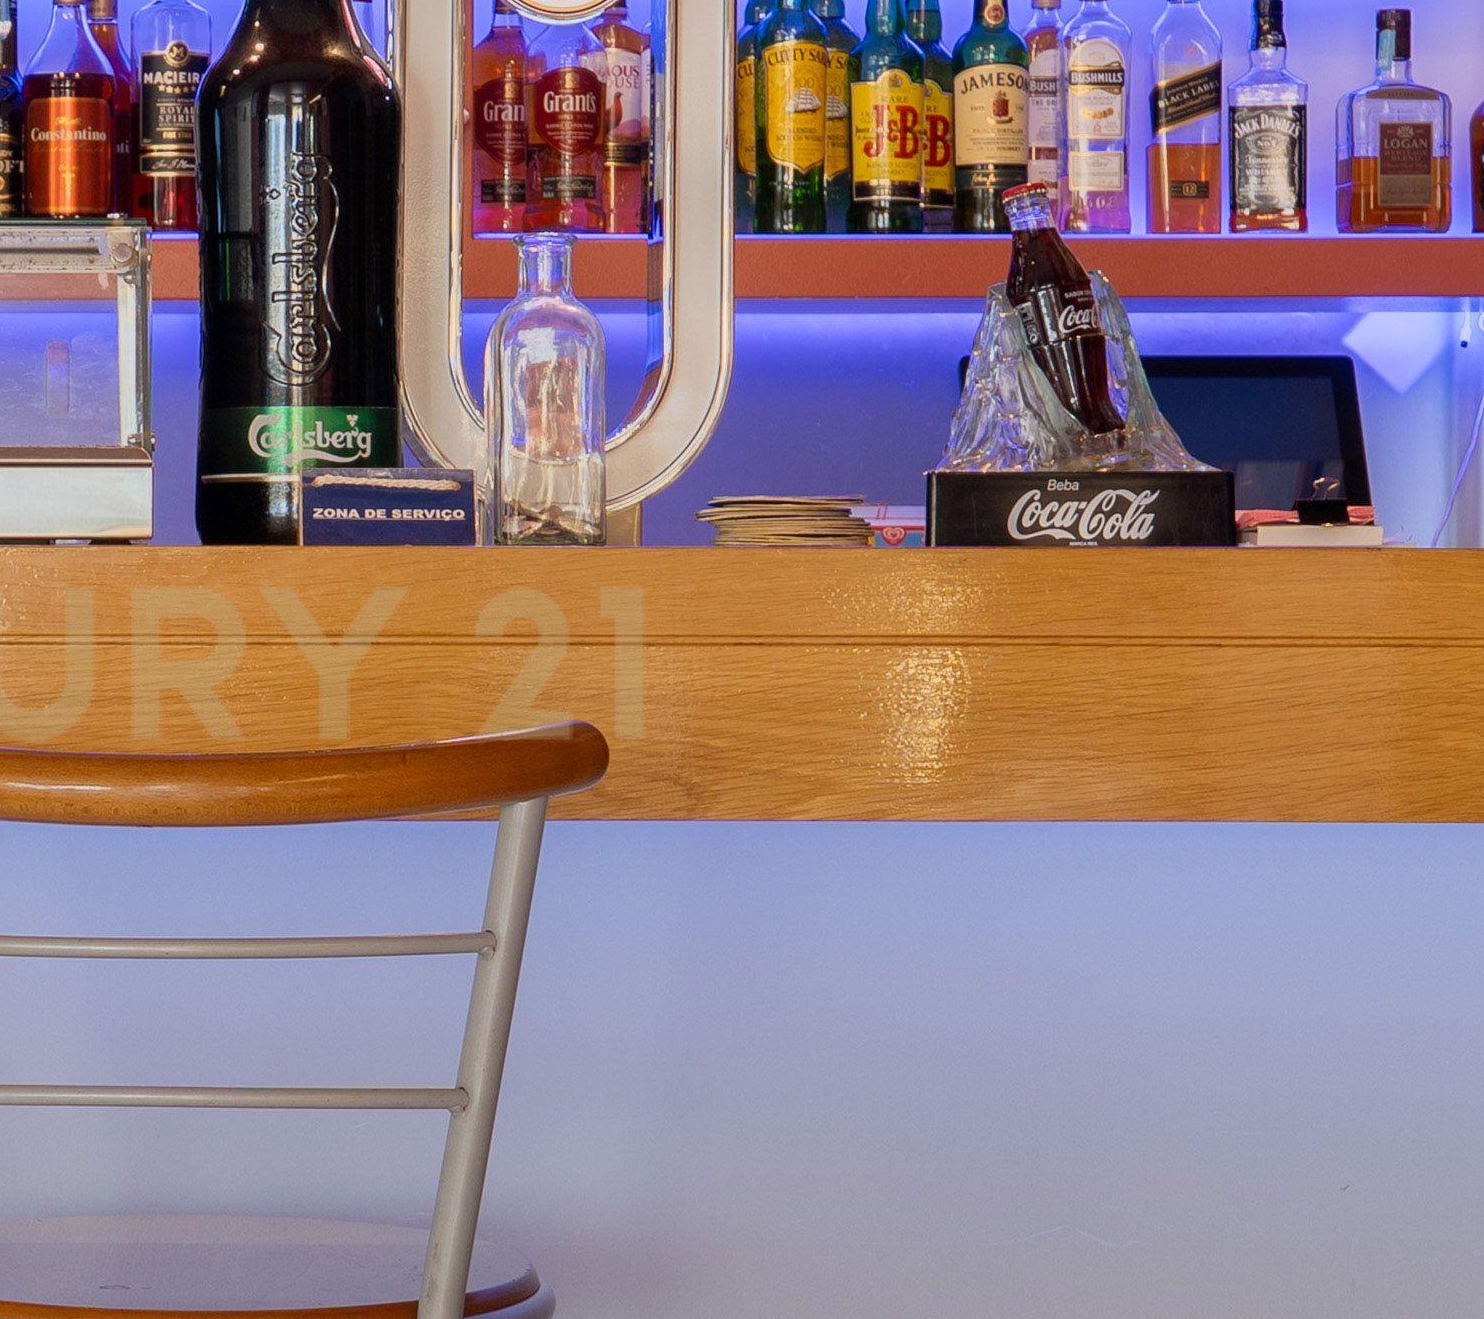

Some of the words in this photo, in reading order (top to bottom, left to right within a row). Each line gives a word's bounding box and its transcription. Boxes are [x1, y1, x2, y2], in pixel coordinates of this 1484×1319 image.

[144, 72, 202, 84] MACIEIR
[1070, 70, 1123, 84] BUSHMILLS
[543, 90, 597, 113] Grant's
[863, 104, 922, 159] J&B
[1235, 119, 1261, 138] JACK
[1261, 114, 1300, 135] DANIEL'S
[31, 127, 107, 142] Constantino
[1384, 138, 1428, 150] LOGAN
[248, 414, 372, 468] Carlsberg
[1047, 479, 1079, 491] Beba
[312, 508, 359, 519] ZONA
[364, 508, 386, 519] DE
[391, 508, 465, 521] SERVIÇO
[1007, 488, 1160, 540] Coca-Cola
